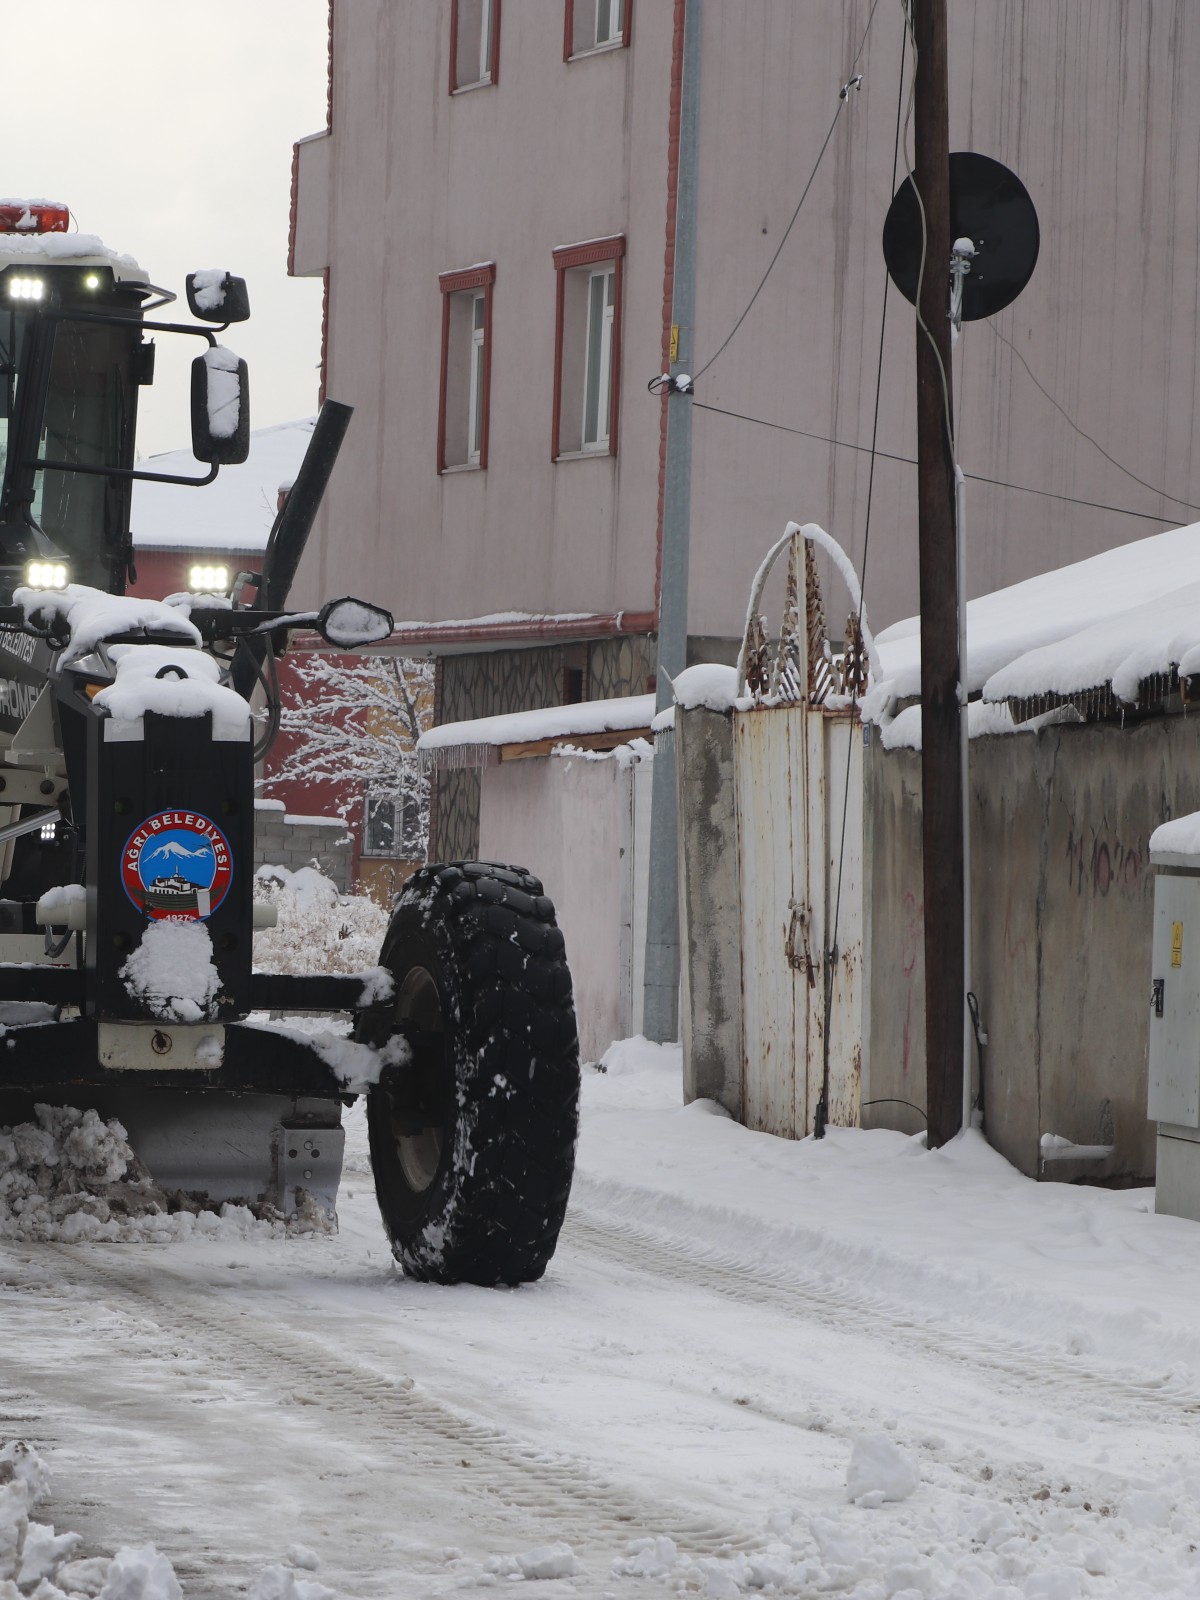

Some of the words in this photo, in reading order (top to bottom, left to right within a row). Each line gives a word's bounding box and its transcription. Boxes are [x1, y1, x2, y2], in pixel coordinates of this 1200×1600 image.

[127, 830, 149, 872] AĞRI
[149, 813, 230, 872] BELEDİYESİ
[166, 914, 190, 922] 1927
